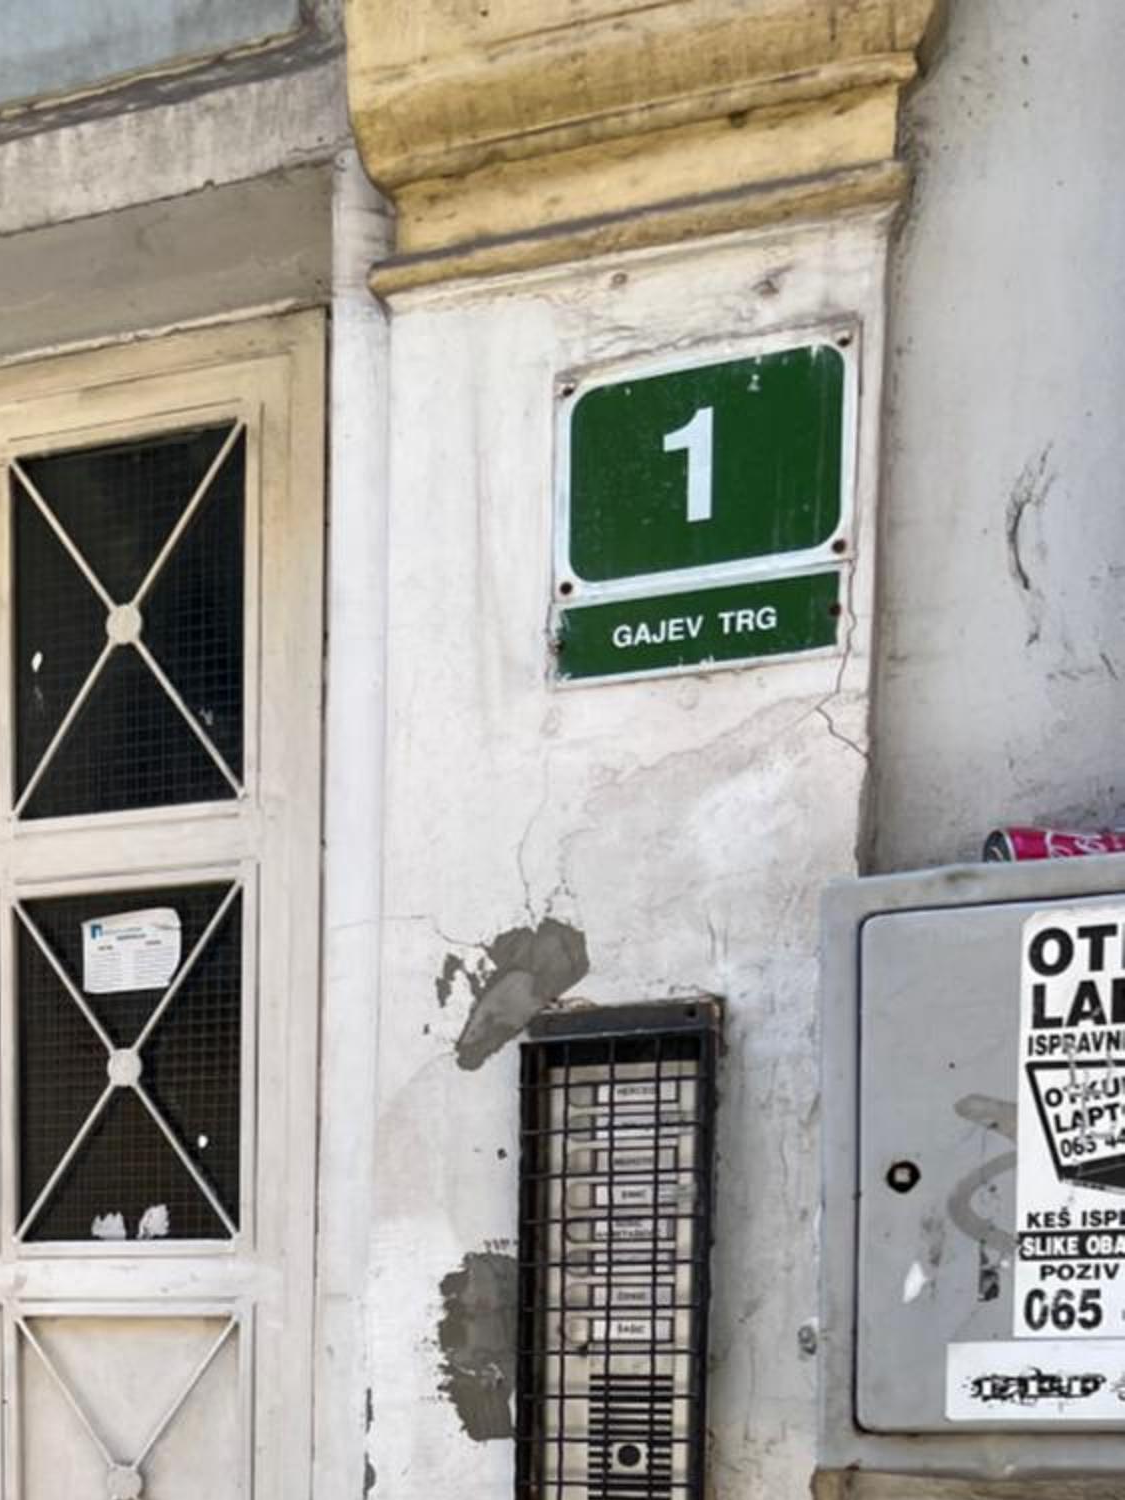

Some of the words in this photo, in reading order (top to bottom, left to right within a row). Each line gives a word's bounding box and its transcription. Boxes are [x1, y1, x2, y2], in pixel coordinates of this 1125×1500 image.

[663, 406, 714, 522] 1
[612, 615, 704, 648] GAJEV
[718, 606, 777, 634] TRG
[1028, 923, 1125, 977] OT
[1028, 1030, 1125, 1056] ISPRAVN
[1053, 1103, 1125, 1133] LAPT
[1027, 1206, 1071, 1229] KEŠ
[1022, 1236, 1079, 1256] SLIKE
[1040, 1263, 1120, 1281] POZIV
[1024, 1288, 1103, 1330] 065
